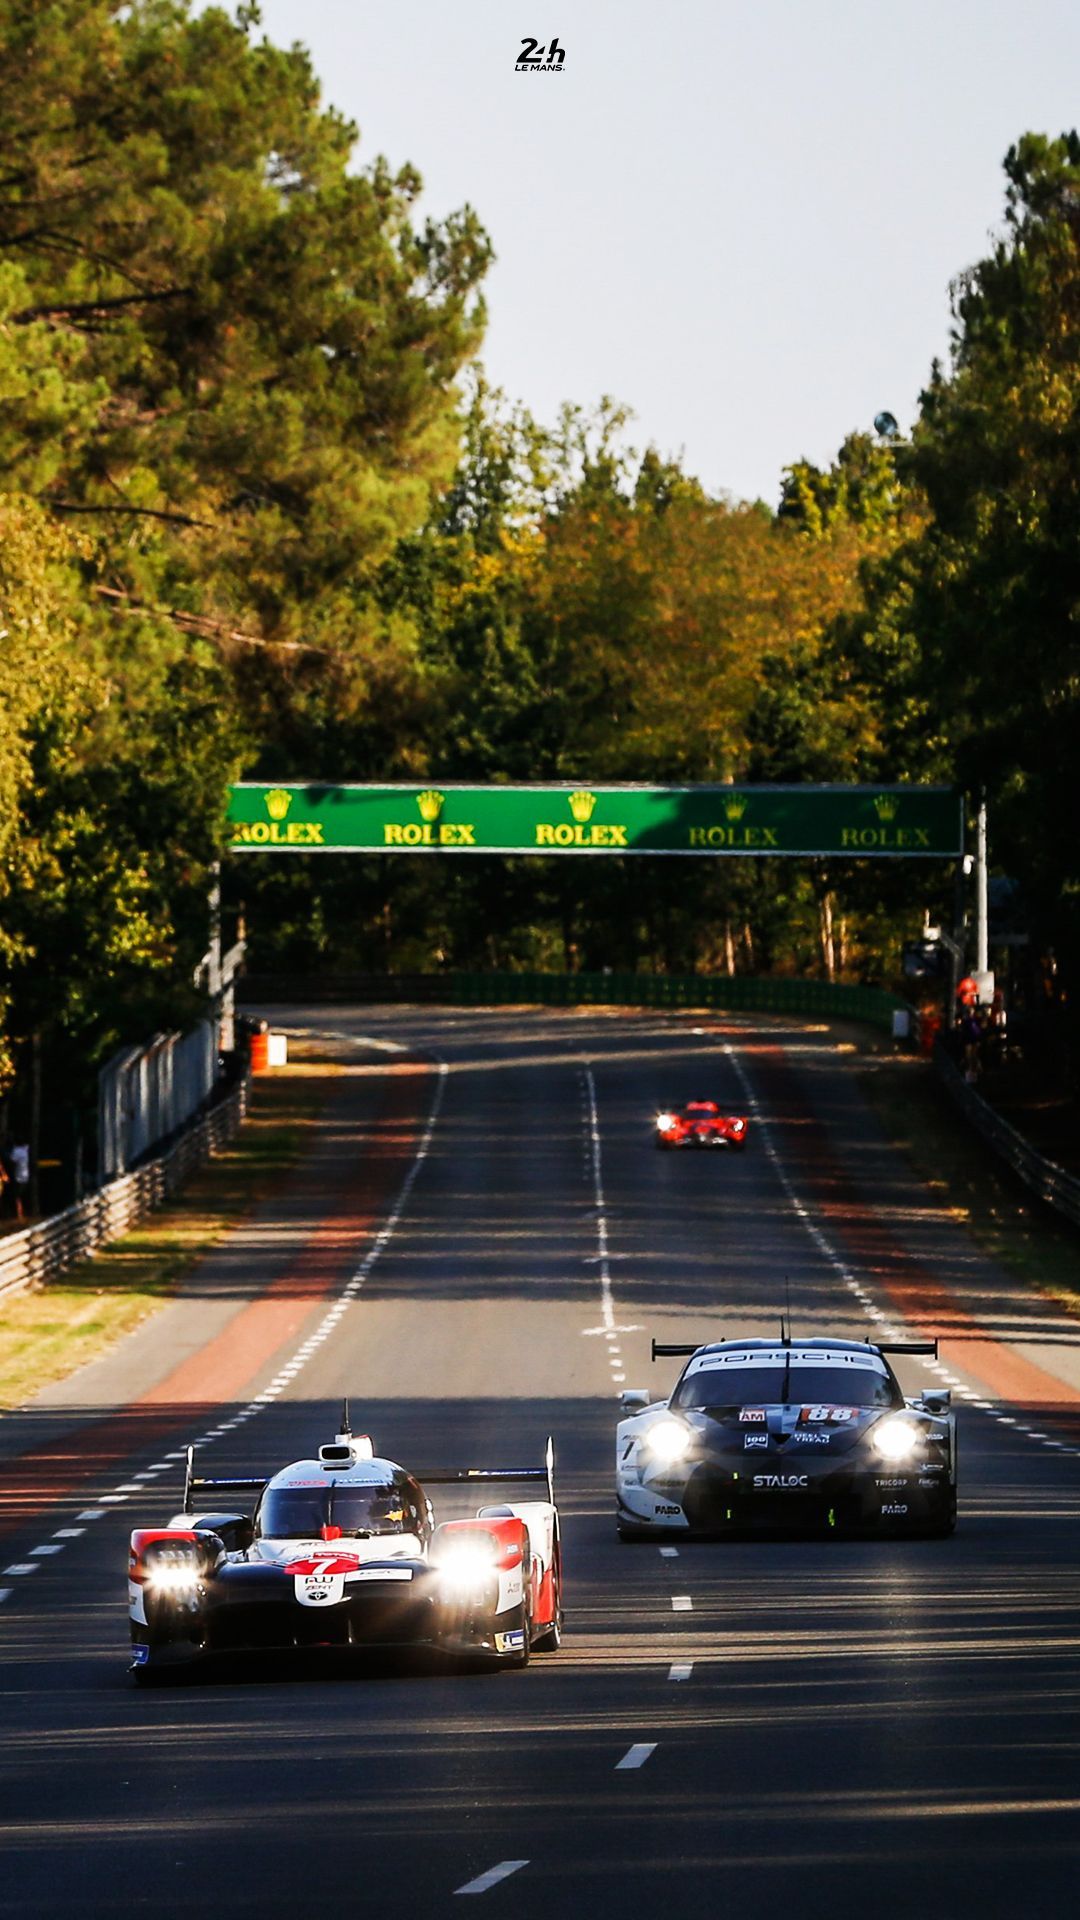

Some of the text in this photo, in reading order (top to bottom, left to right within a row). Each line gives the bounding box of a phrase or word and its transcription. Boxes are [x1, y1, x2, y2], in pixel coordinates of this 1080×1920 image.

[384, 824, 475, 845] ROLEX
[535, 824, 627, 846] ROLEX
[688, 827, 779, 847] ROLEX
[840, 827, 930, 847] ROLEX
[700, 1354, 873, 1367] PORSCHE
[740, 1411, 765, 1421] AM
[808, 1408, 853, 1421] 88
[753, 1475, 808, 1487] STALOC
[655, 1506, 681, 1514] FARO
[881, 1505, 908, 1514] FARO
[308, 1559, 338, 1575] 7
